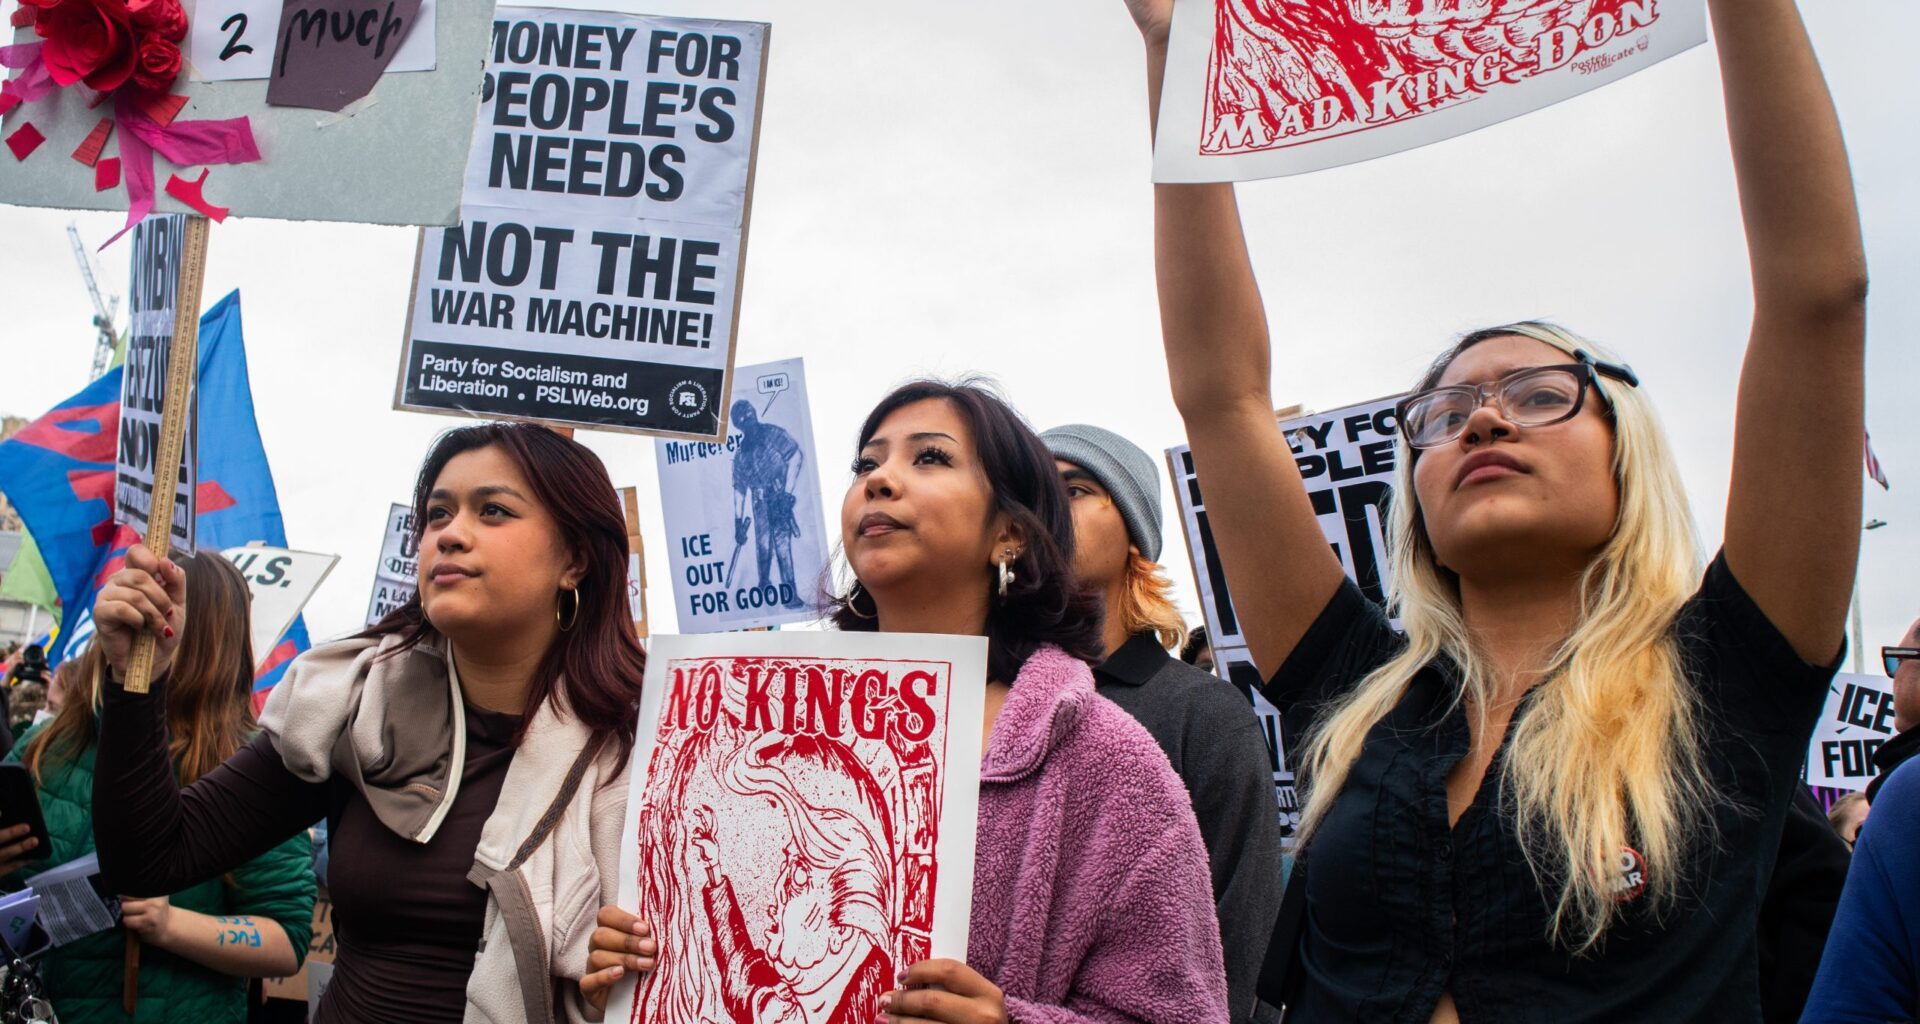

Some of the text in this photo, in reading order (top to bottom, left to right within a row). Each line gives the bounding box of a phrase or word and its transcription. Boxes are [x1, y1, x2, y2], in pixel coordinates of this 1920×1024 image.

[219, 13, 254, 61] 2
[646, 30, 742, 81] FOR
[1579, 47, 1635, 75] Syndicate
[1201, 96, 1344, 152] MAD
[1528, 0, 1659, 76] DON
[488, 133, 686, 201] NEEDS
[437, 221, 720, 305] NOT THE
[431, 288, 713, 349] WAR MACHINE!
[418, 373, 649, 416] Liberation PSLWeb.org
[421, 353, 628, 389] Party for Socialism and
[679, 391, 697, 407] PSL
[682, 534, 712, 558] ICE
[686, 561, 724, 586] OUT
[690, 584, 794, 616] FOR GOOD
[663, 664, 938, 743] NO KINGS
[1837, 683, 1895, 735] ICE
